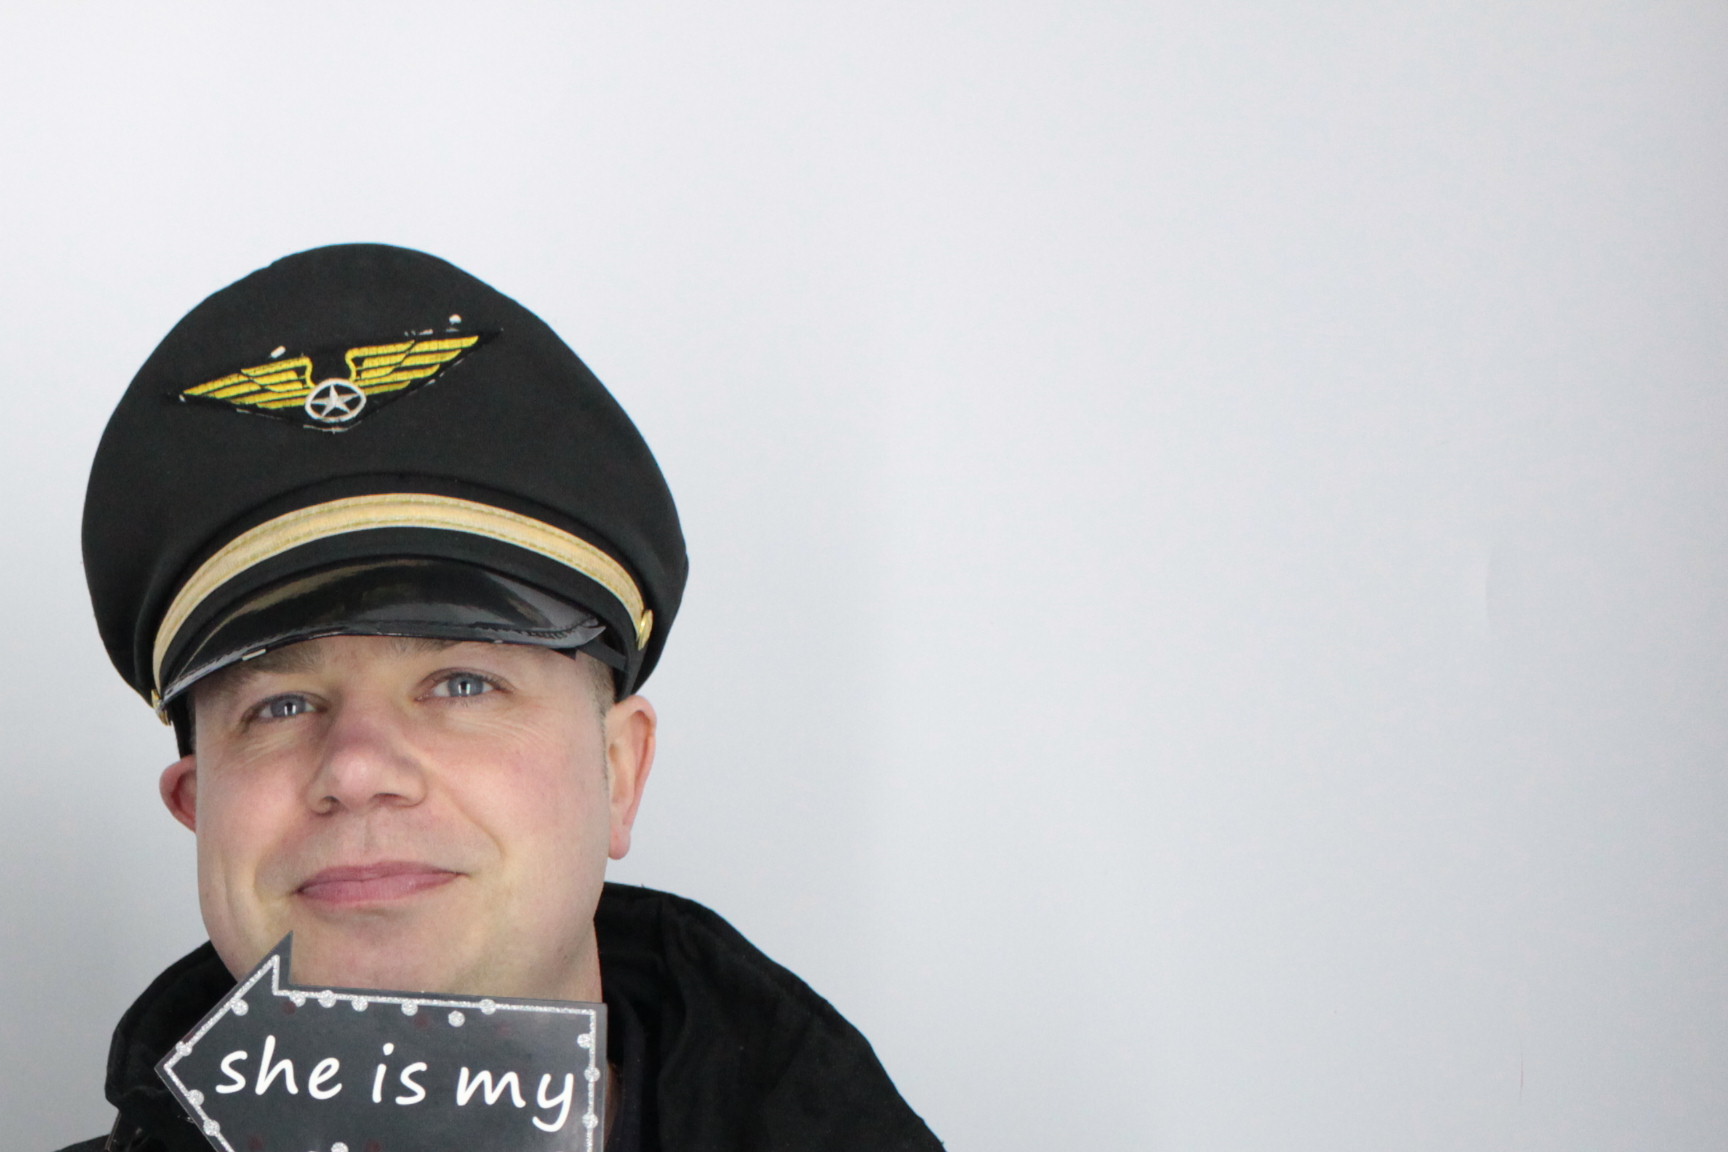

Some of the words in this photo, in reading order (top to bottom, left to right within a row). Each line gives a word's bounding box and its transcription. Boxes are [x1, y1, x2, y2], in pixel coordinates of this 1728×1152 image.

[215, 1034, 344, 1100] she
[371, 1042, 428, 1106] is
[455, 1066, 576, 1133] my
